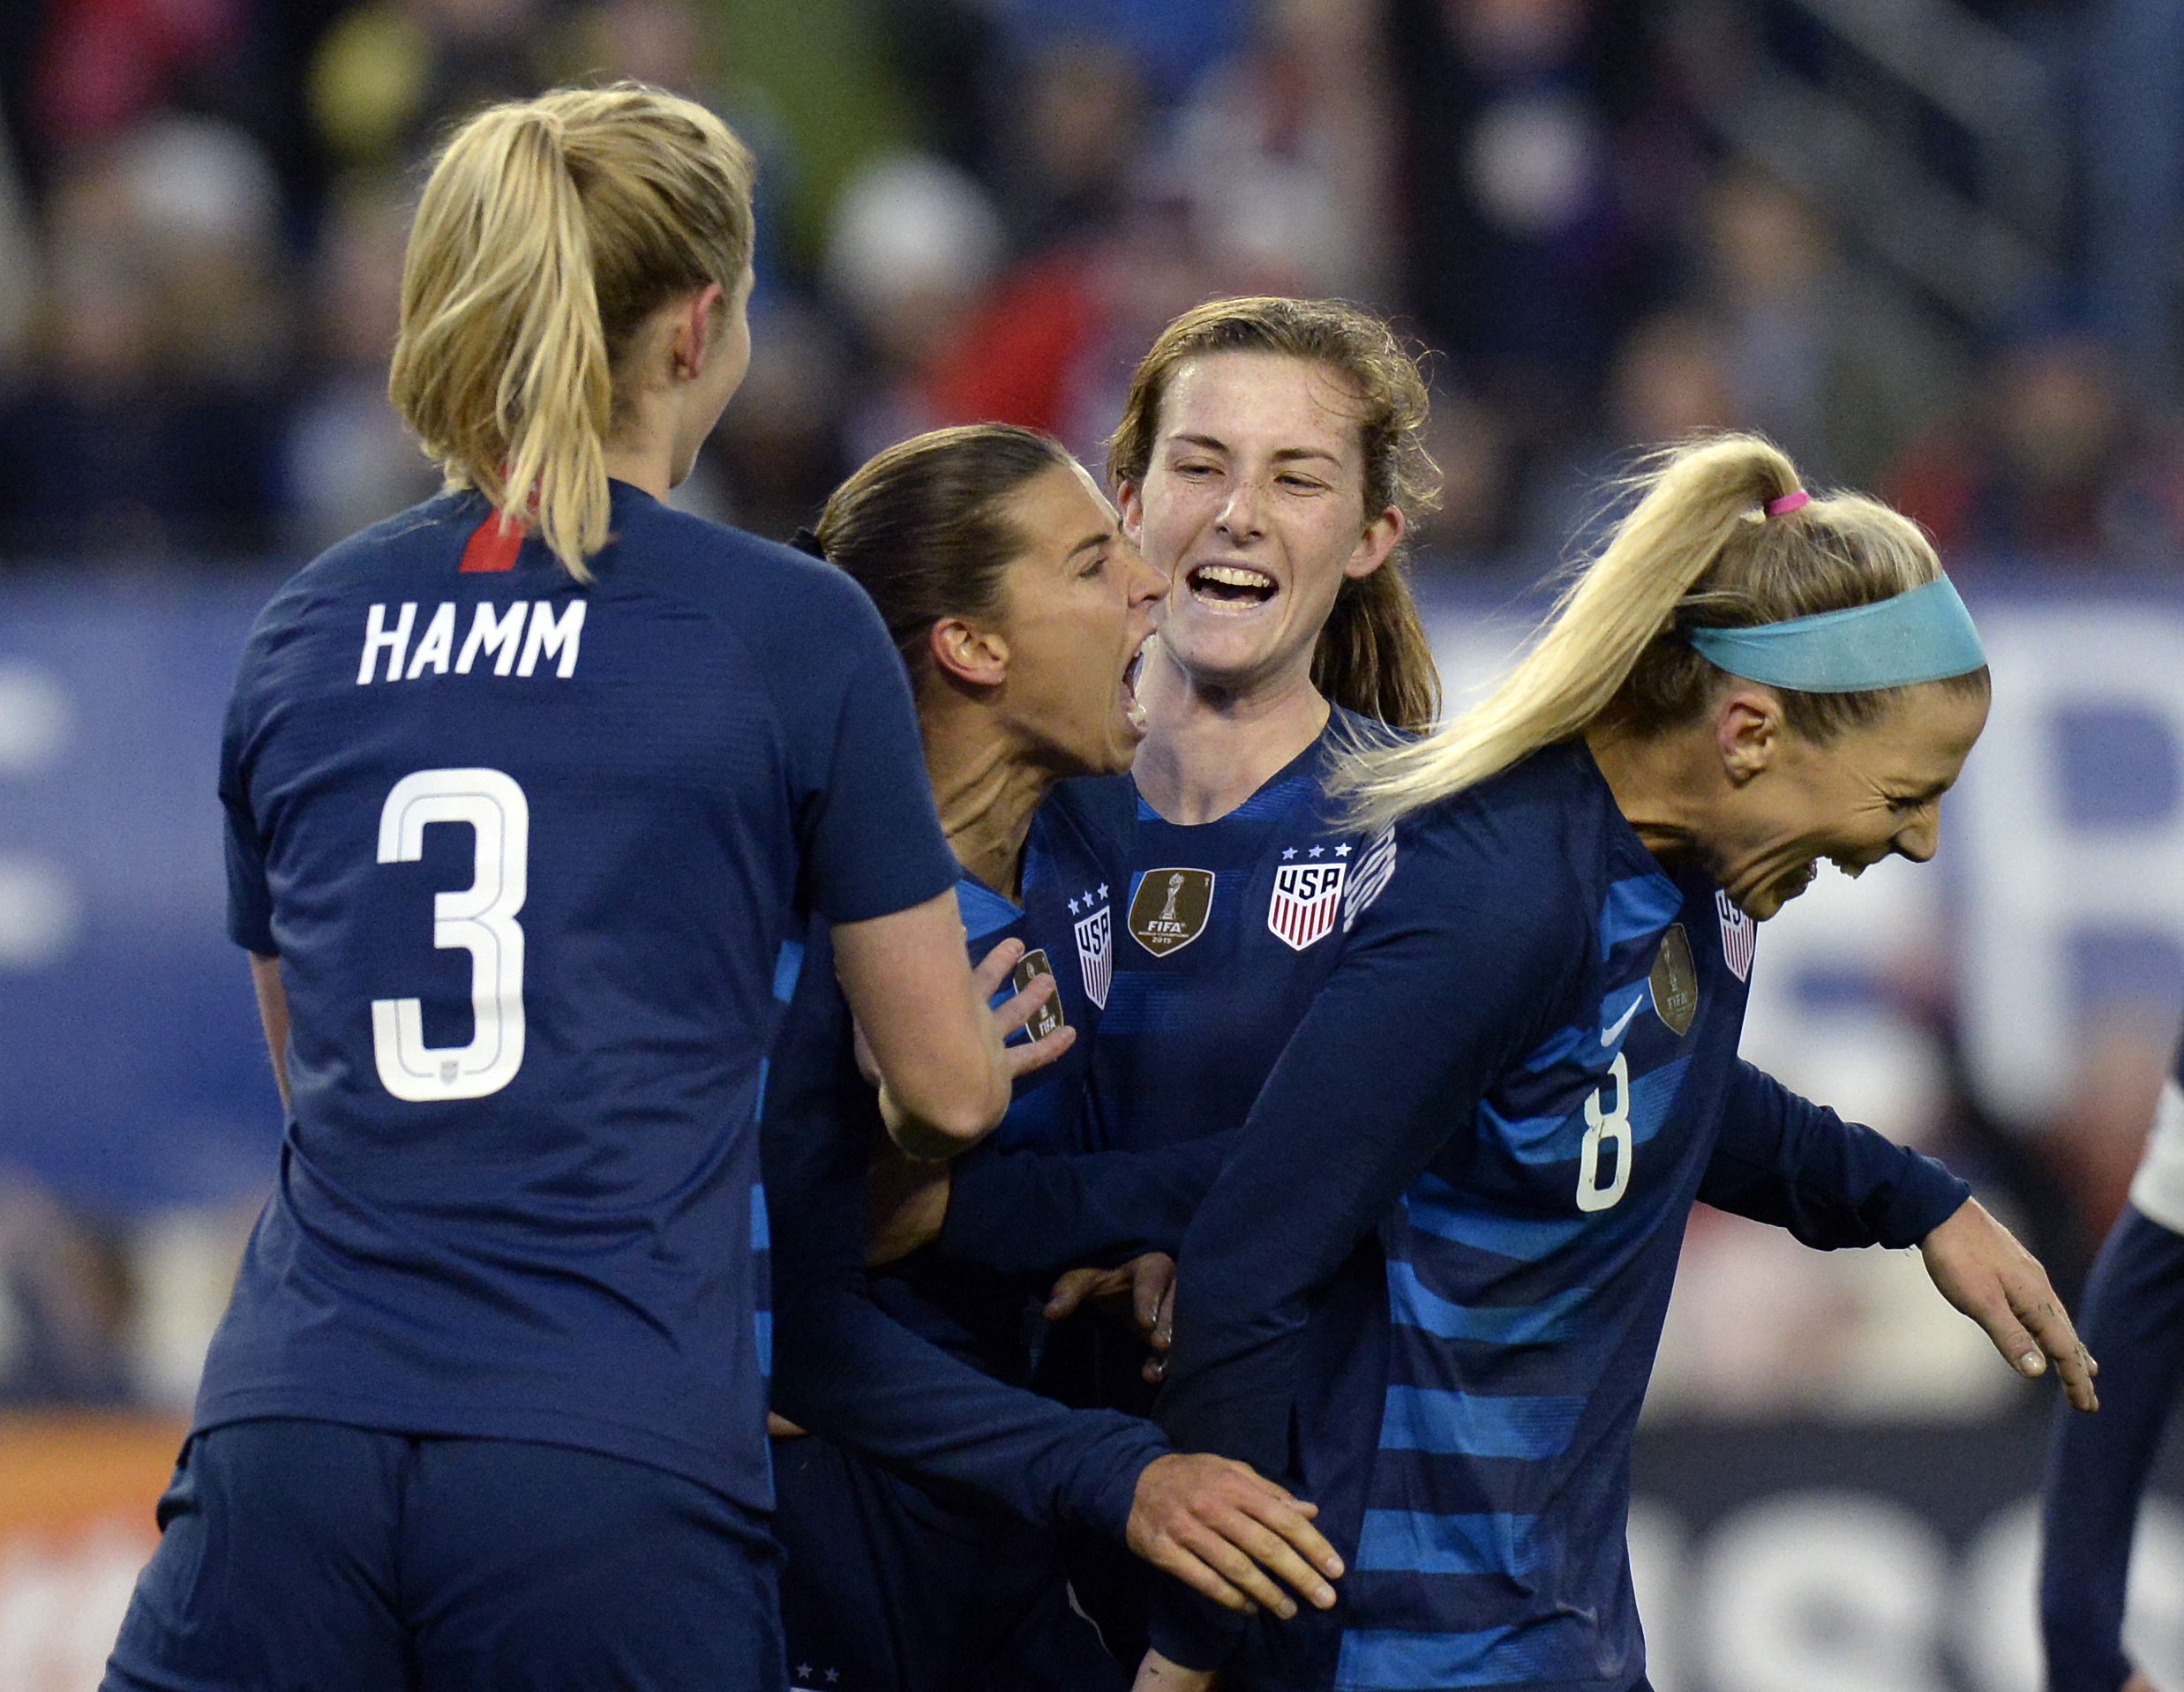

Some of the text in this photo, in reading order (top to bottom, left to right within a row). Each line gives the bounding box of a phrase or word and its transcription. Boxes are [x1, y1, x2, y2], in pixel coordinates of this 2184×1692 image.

[356, 599, 587, 685] HAMM
[1279, 868, 1340, 900] USA
[372, 767, 529, 1102] 3
[1077, 912, 1109, 955] USA
[1148, 920, 1181, 933] FIFA
[1039, 1014, 1056, 1037] FIFA
[1576, 1052, 1632, 1213] 8
